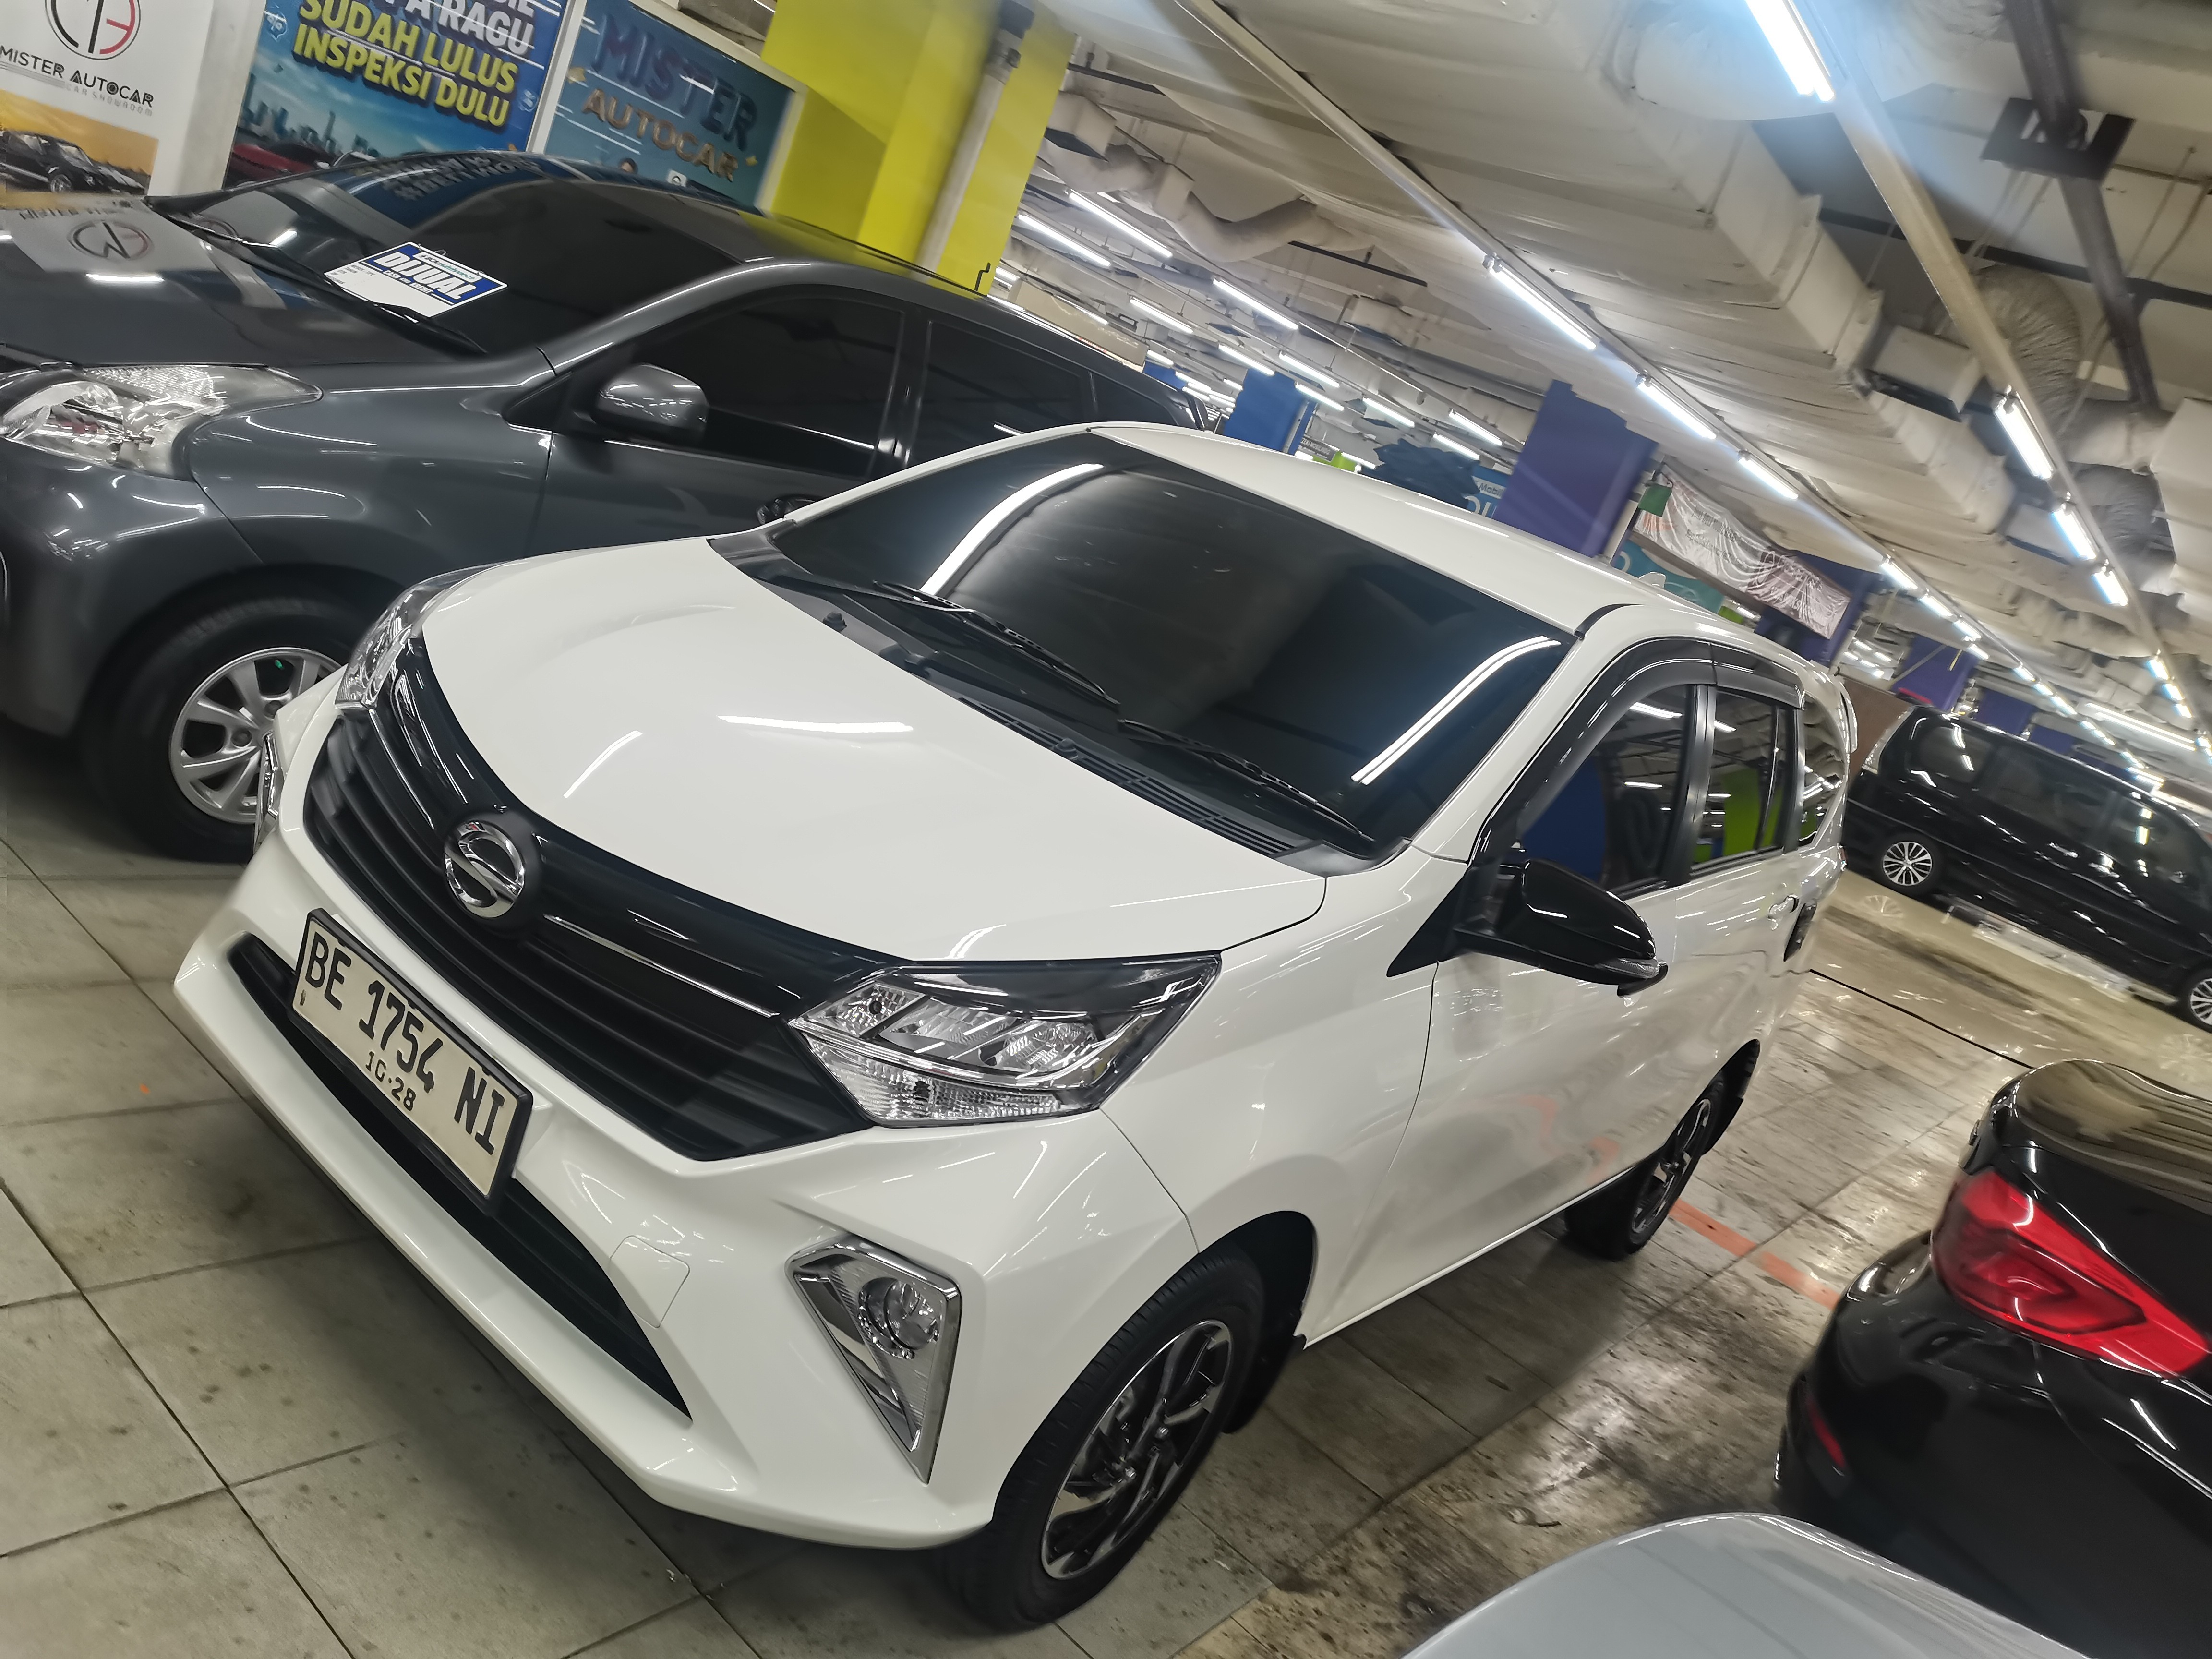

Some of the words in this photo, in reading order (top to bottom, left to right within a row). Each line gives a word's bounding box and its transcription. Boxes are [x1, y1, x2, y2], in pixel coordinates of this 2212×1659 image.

[294, 23, 432, 100] INSPEKSI
[435, 76, 509, 127] DULU
[300, 0, 421, 58] SUDAH
[422, 32, 518, 94] LULUS
[438, 0, 535, 56] RAGU
[0, 45, 64, 78] MISTER
[70, 70, 154, 108] AUTOCAR
[590, 13, 758, 152] MISTER
[581, 88, 739, 183] AUTOCAR
[373, 252, 477, 300] DIJUAL
[383, 270, 402, 279] CASH
[409, 282, 434, 294] KREDIT
[305, 932, 351, 1010] BE
[359, 980, 443, 1093] 1754
[454, 1067, 505, 1155] NI
